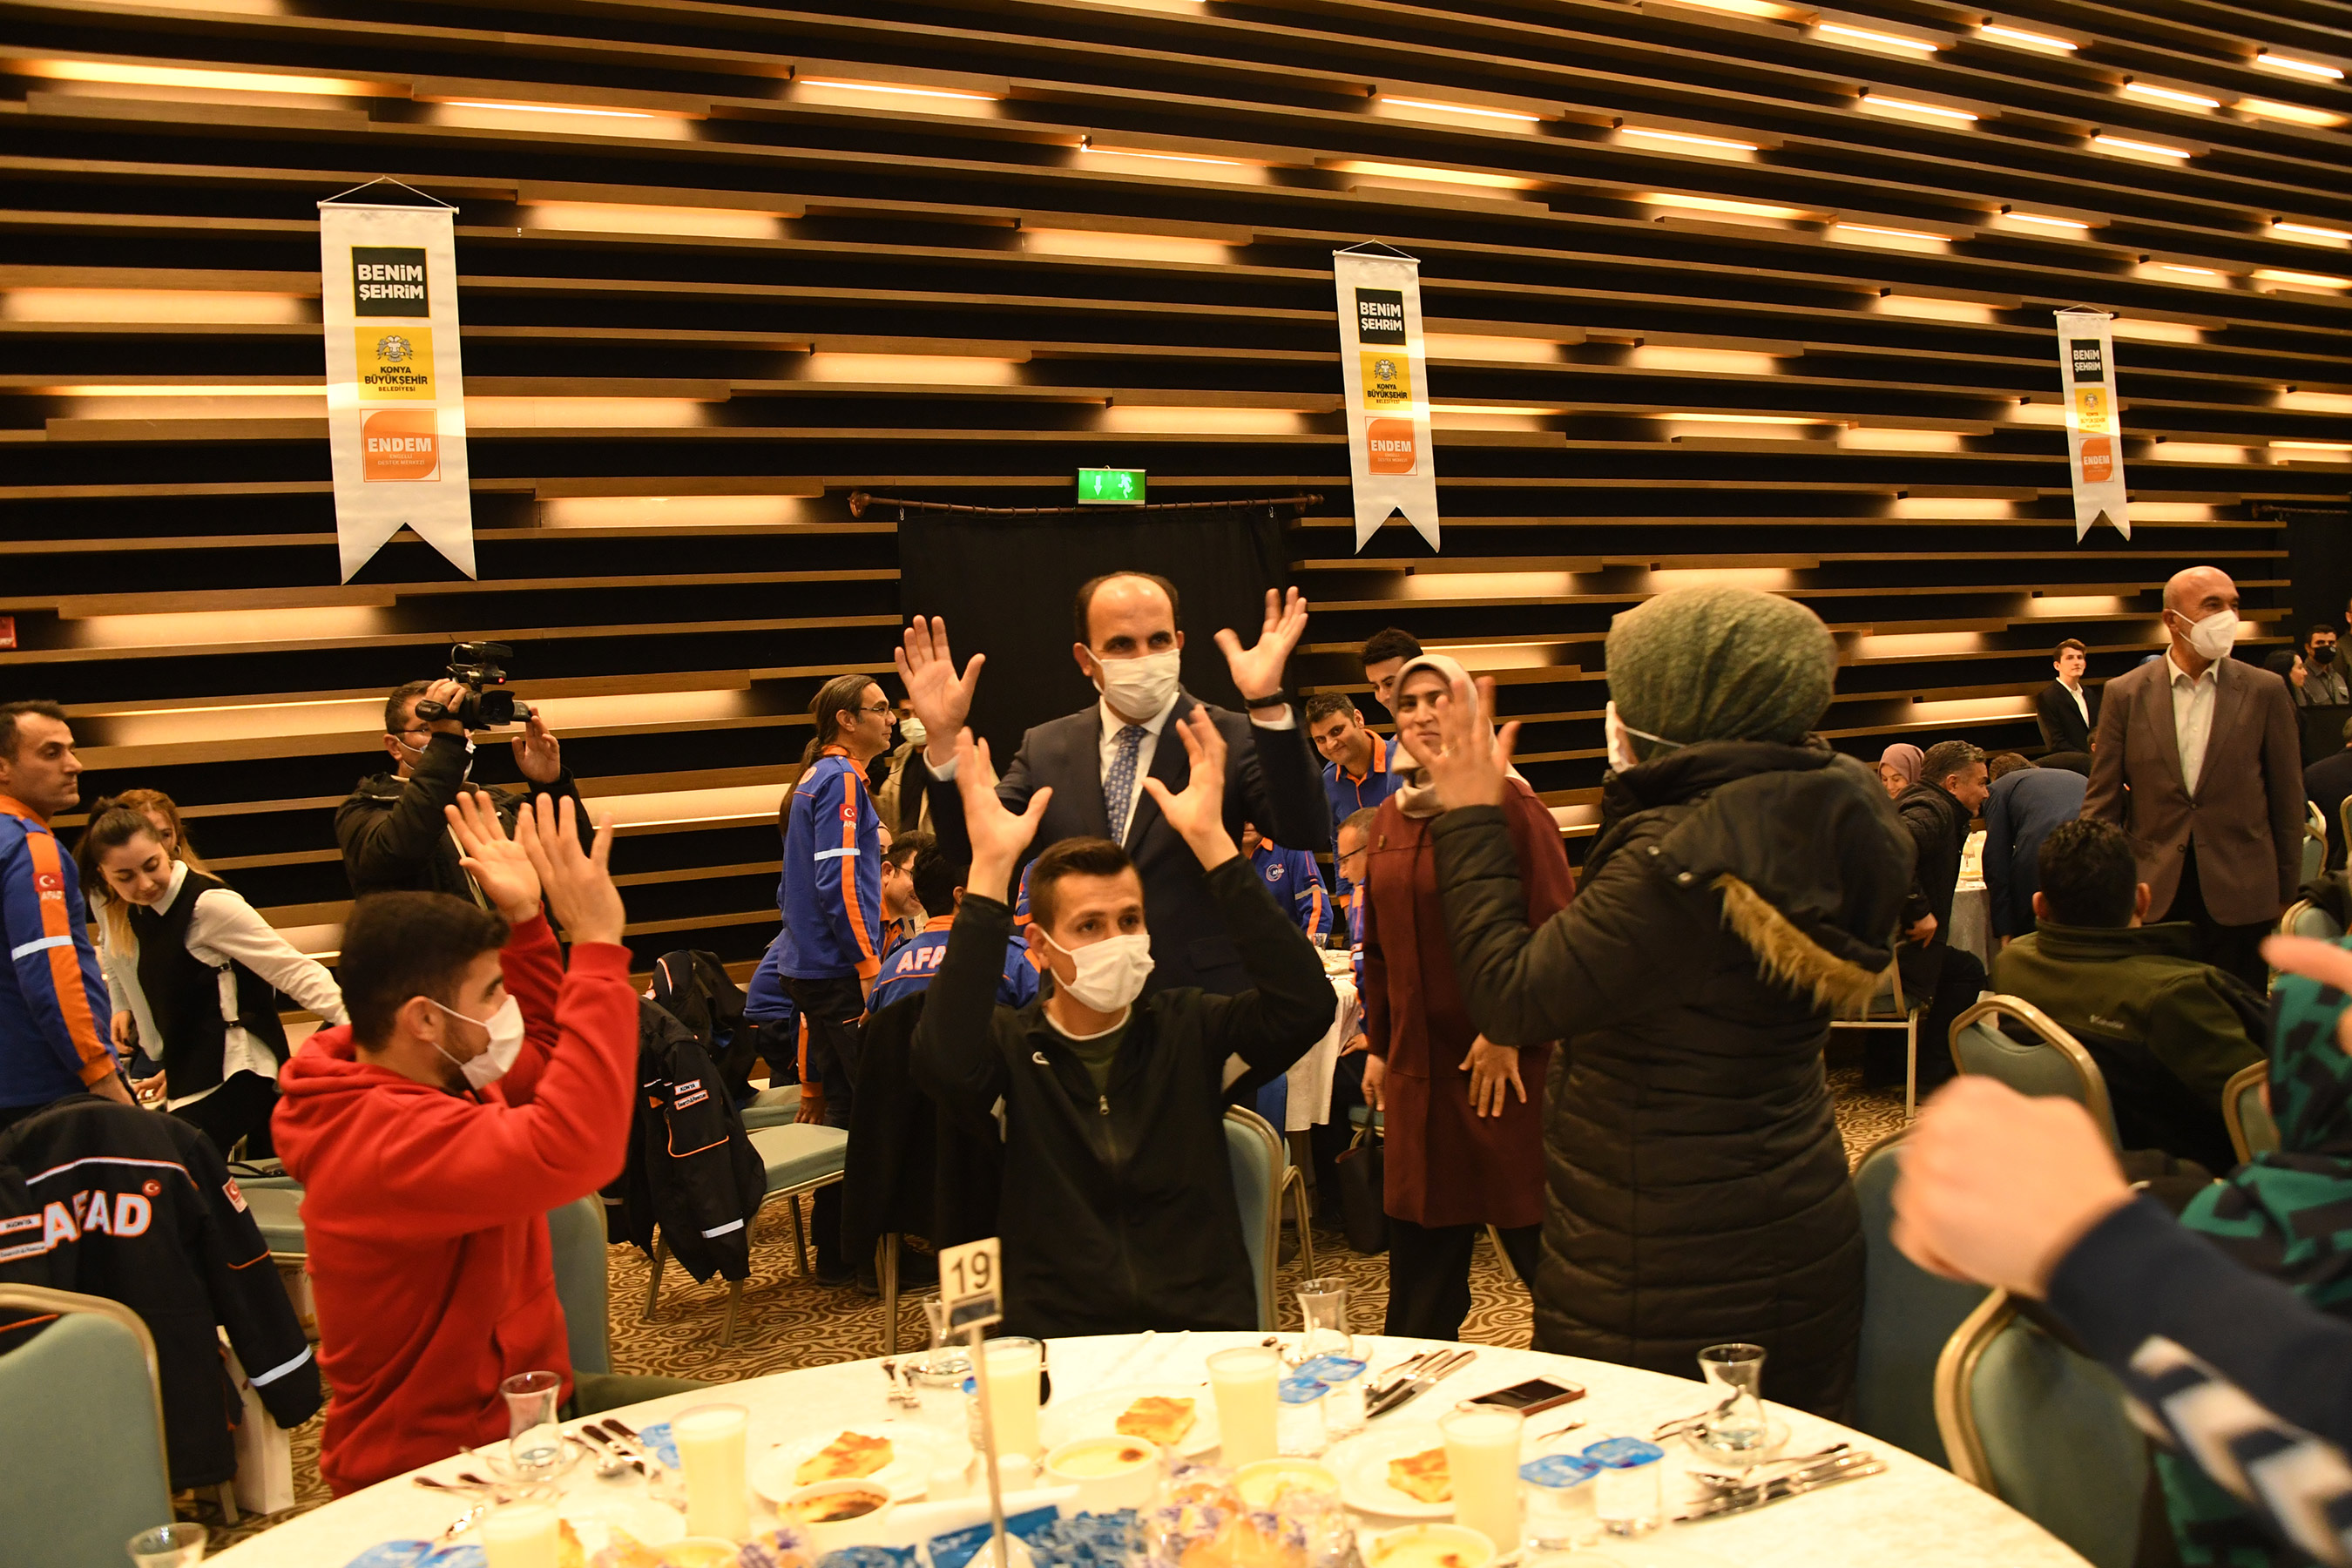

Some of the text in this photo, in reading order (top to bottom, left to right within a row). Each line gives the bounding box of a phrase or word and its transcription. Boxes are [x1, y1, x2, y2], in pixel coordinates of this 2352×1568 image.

[364, 374, 428, 385] BÜYÜKŞEHİR
[368, 437, 432, 452] ENDEM
[1370, 439, 1412, 452] ENDEM
[2083, 455, 2110, 465] ENDEM
[896, 945, 947, 974] AFA
[44, 1190, 152, 1251] AFAD
[950, 1251, 990, 1294] 19
